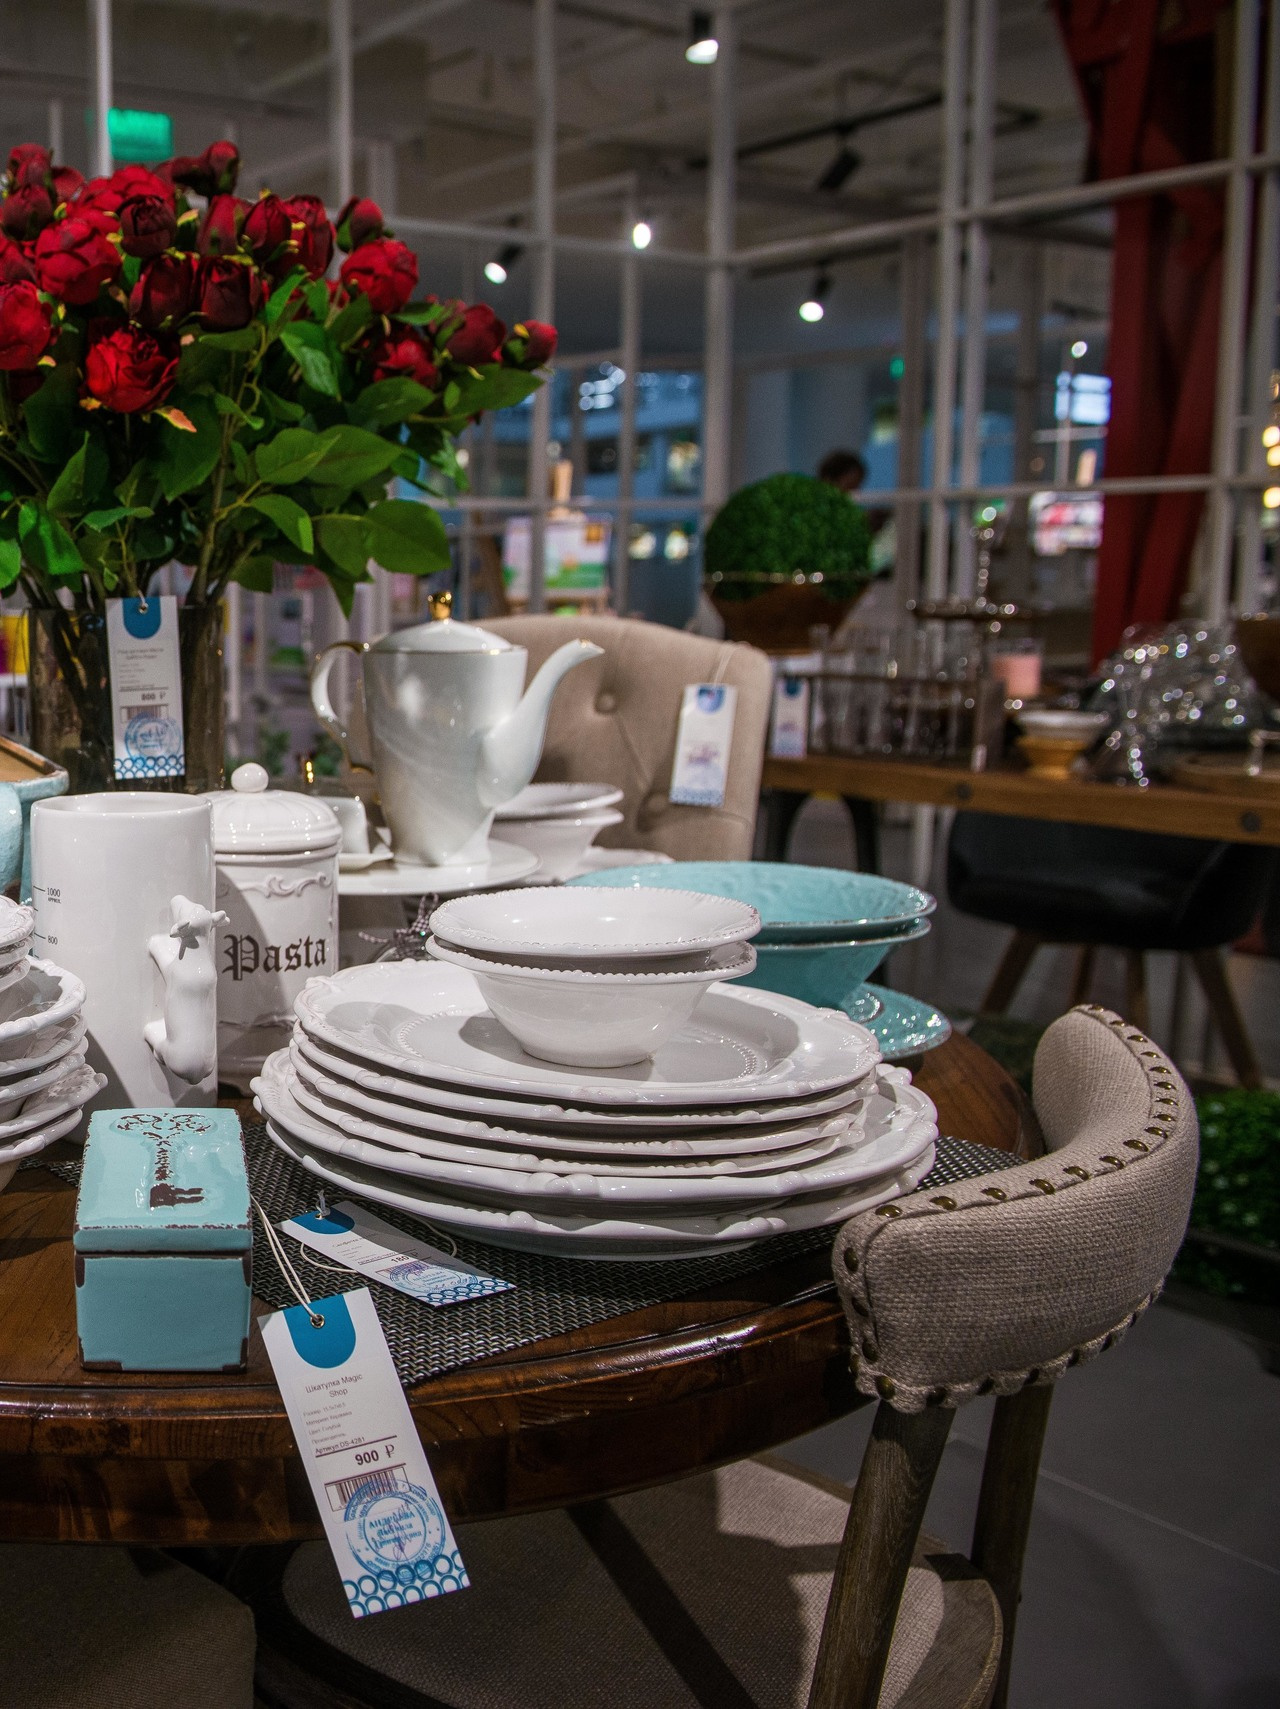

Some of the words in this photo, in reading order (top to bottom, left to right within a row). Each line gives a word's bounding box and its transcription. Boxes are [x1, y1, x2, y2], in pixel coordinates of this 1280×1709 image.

[47, 887, 61, 897] 1000
[47, 935, 58, 945] 800
[222, 934, 327, 981] Pasta
[305, 1379, 341, 1393] Шкатулка
[340, 1374, 363, 1385] Magic
[329, 1388, 348, 1398] Shop
[355, 1450, 380, 1466] 900
